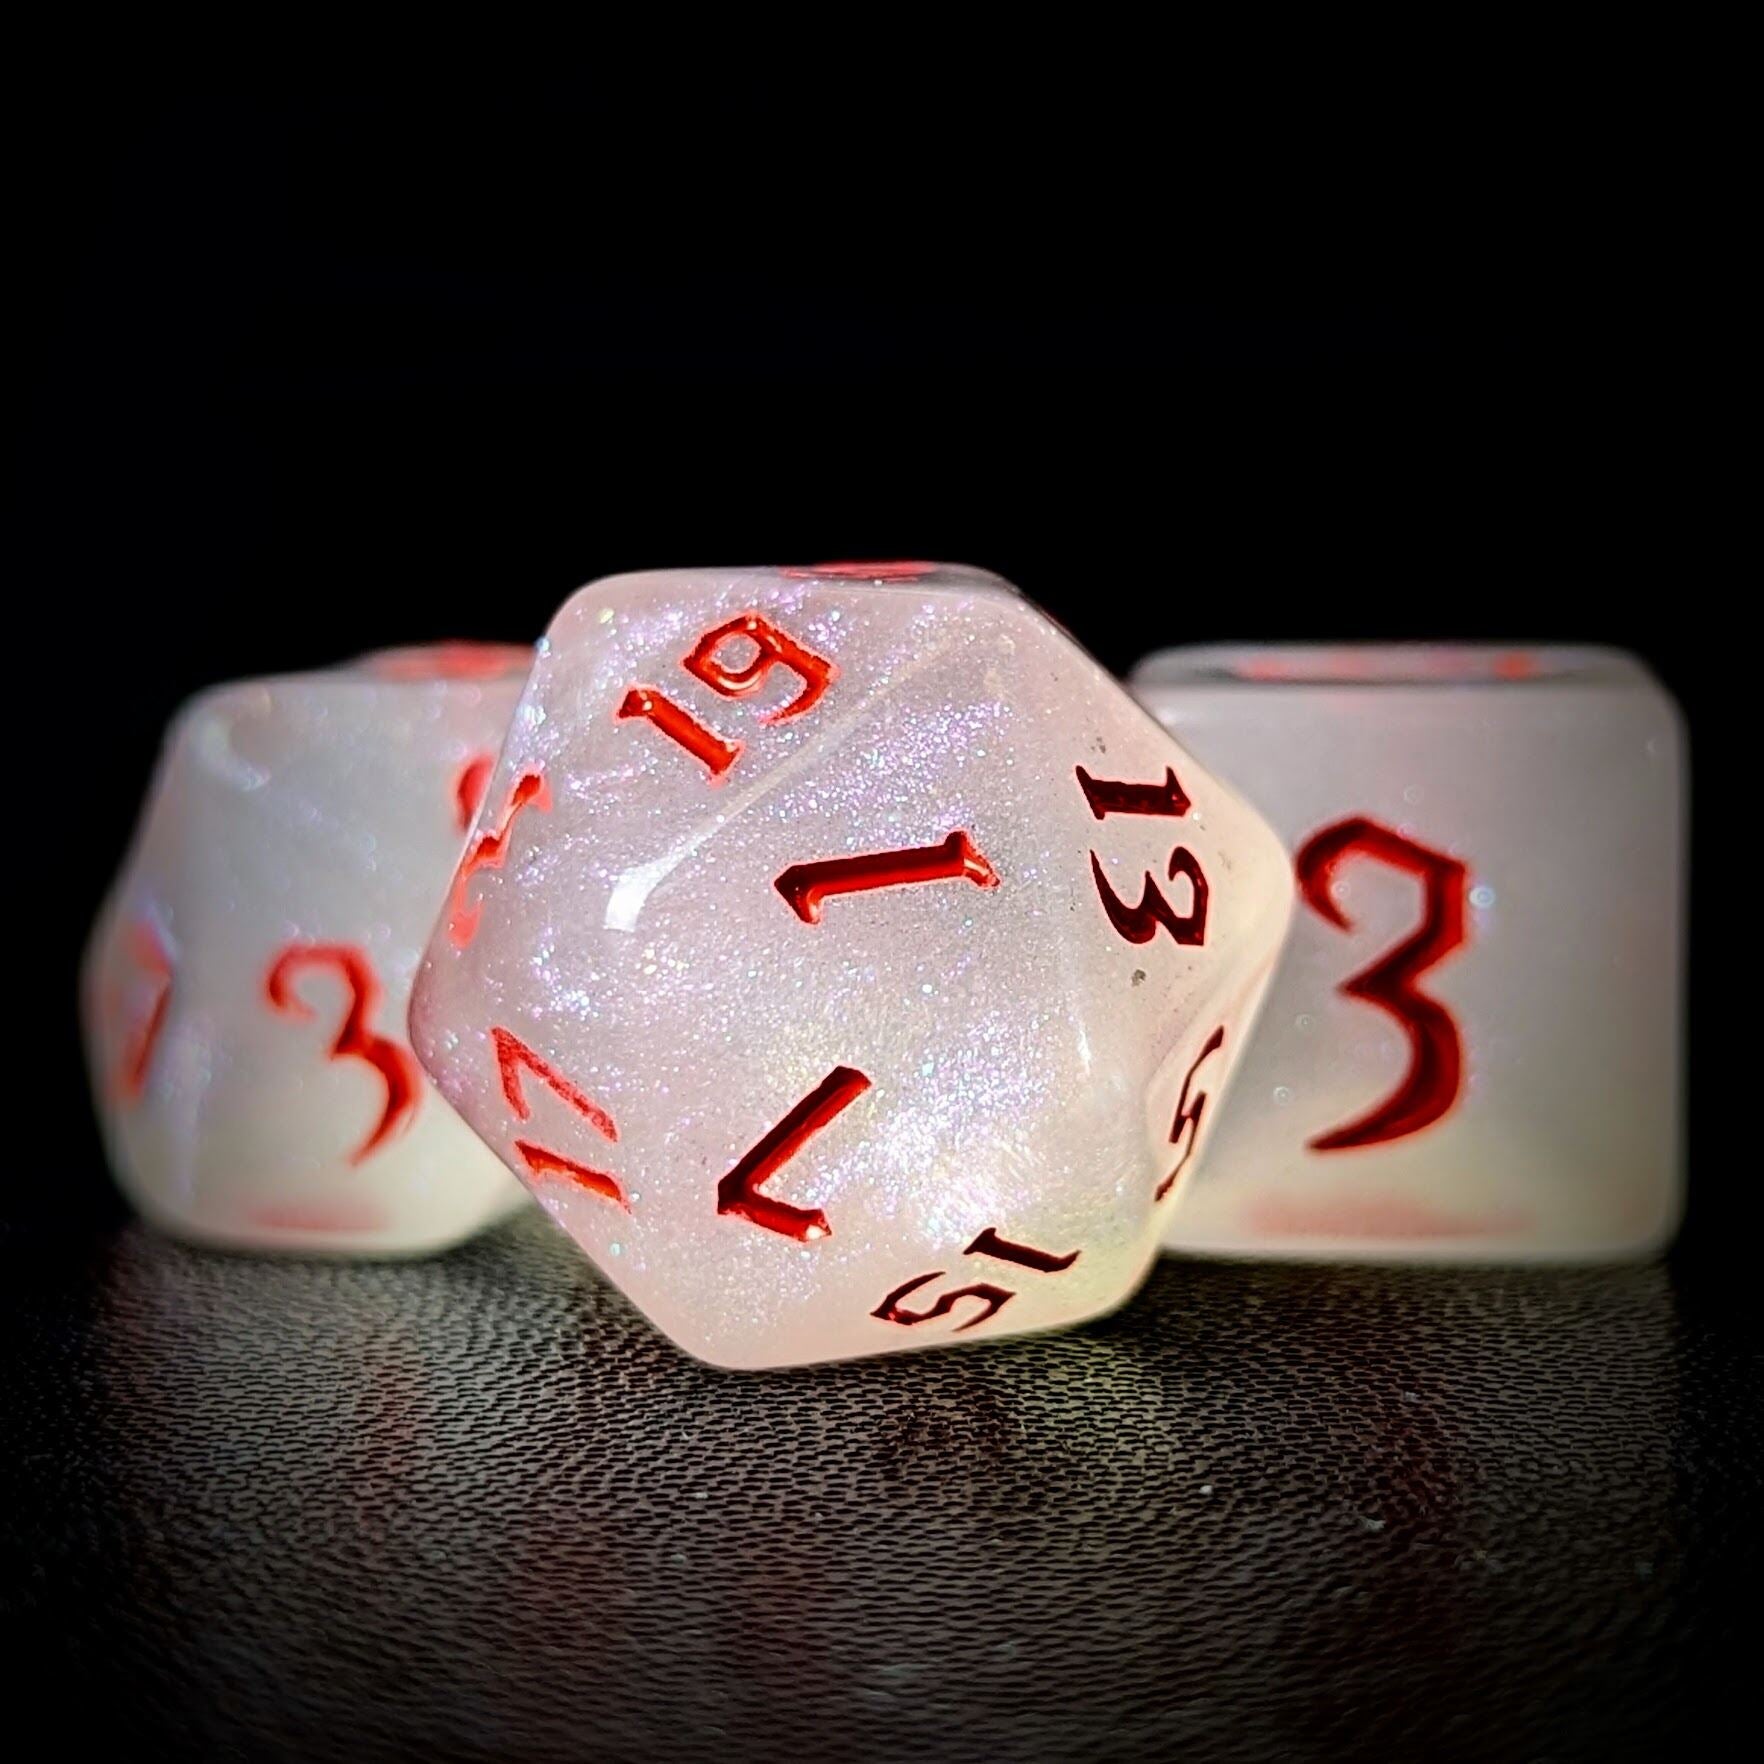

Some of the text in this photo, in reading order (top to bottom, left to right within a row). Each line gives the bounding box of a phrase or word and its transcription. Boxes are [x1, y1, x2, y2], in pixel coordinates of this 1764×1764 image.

[615, 611, 839, 786] 19
[774, 829, 1001, 925] 1
[1075, 765, 1212, 947] 13
[262, 942, 422, 1166] 3
[1295, 813, 1470, 1156] 3
[491, 1026, 632, 1214] 17
[717, 1065, 872, 1242] 7
[870, 1227, 1082, 1333] 15
